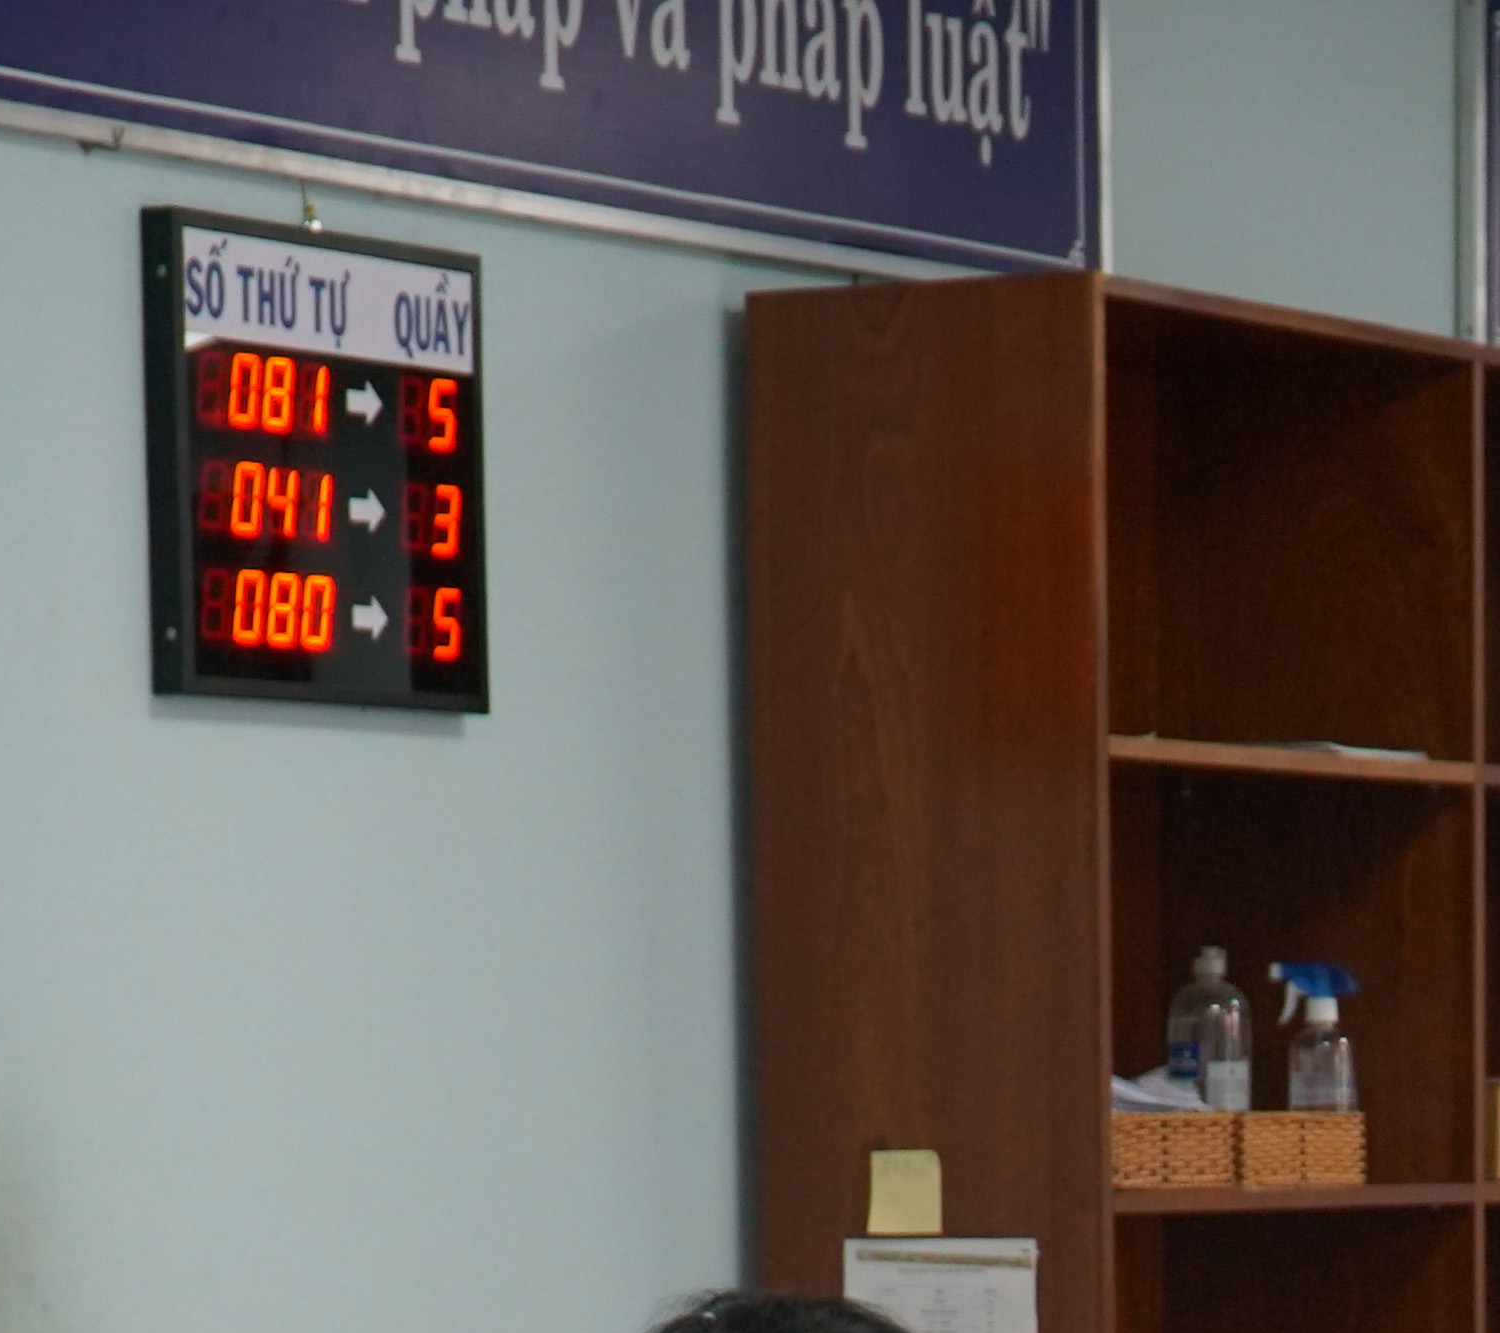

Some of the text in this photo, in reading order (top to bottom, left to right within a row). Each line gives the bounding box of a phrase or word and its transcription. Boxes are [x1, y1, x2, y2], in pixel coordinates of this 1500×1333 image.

[185, 238, 350, 348] SỐ THỨ TỰ
[227, 351, 458, 454] 081 5
[230, 460, 463, 560] 041 3
[232, 567, 462, 662] 080 5
